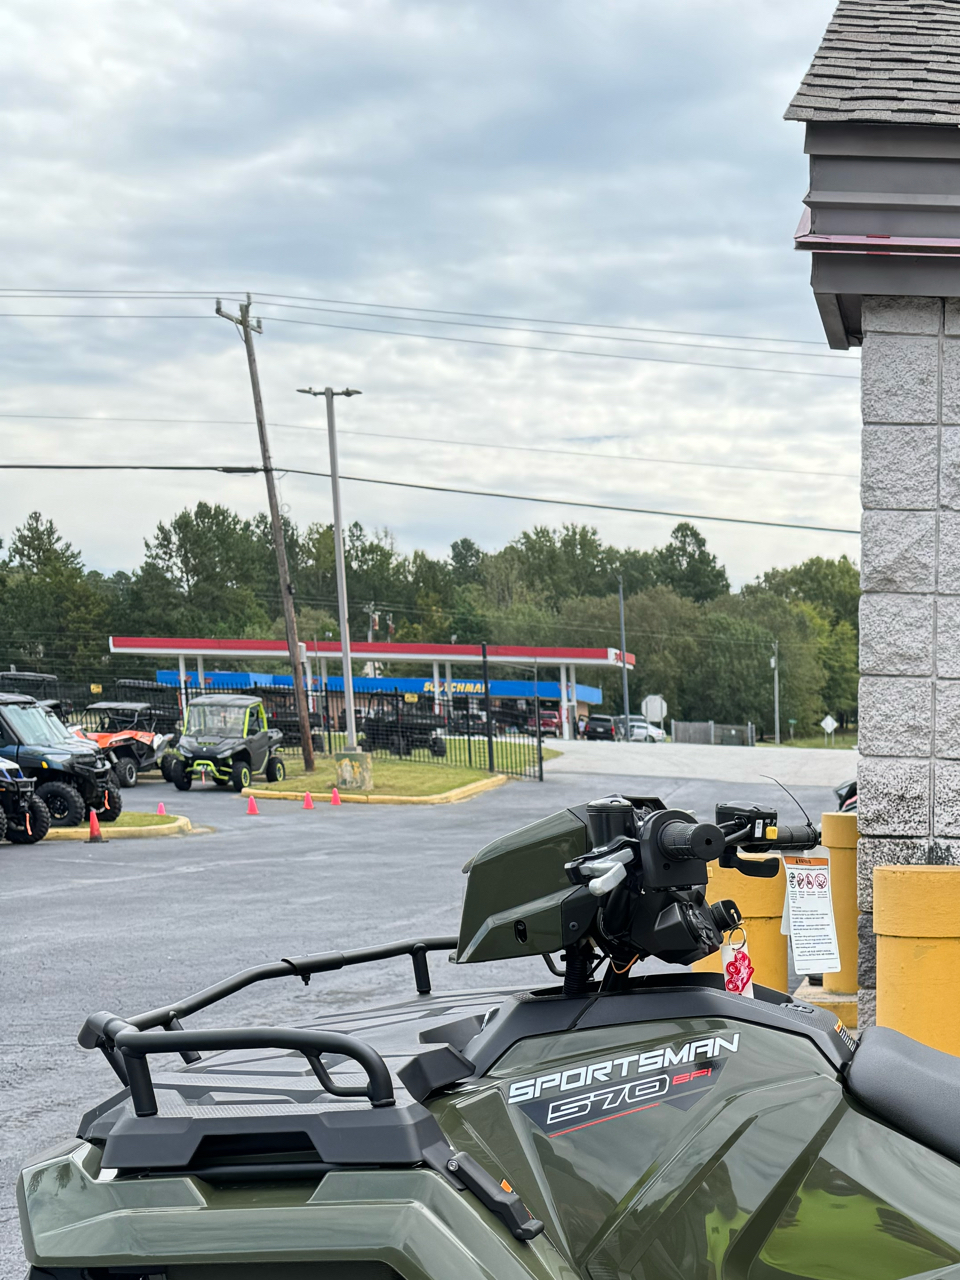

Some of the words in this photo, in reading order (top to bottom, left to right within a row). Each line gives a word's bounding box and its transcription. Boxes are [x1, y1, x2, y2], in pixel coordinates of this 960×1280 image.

[508, 1034, 740, 1104] SPORTSMAN
[547, 1074, 670, 1125] 570
[672, 1068, 712, 1085] EFI
